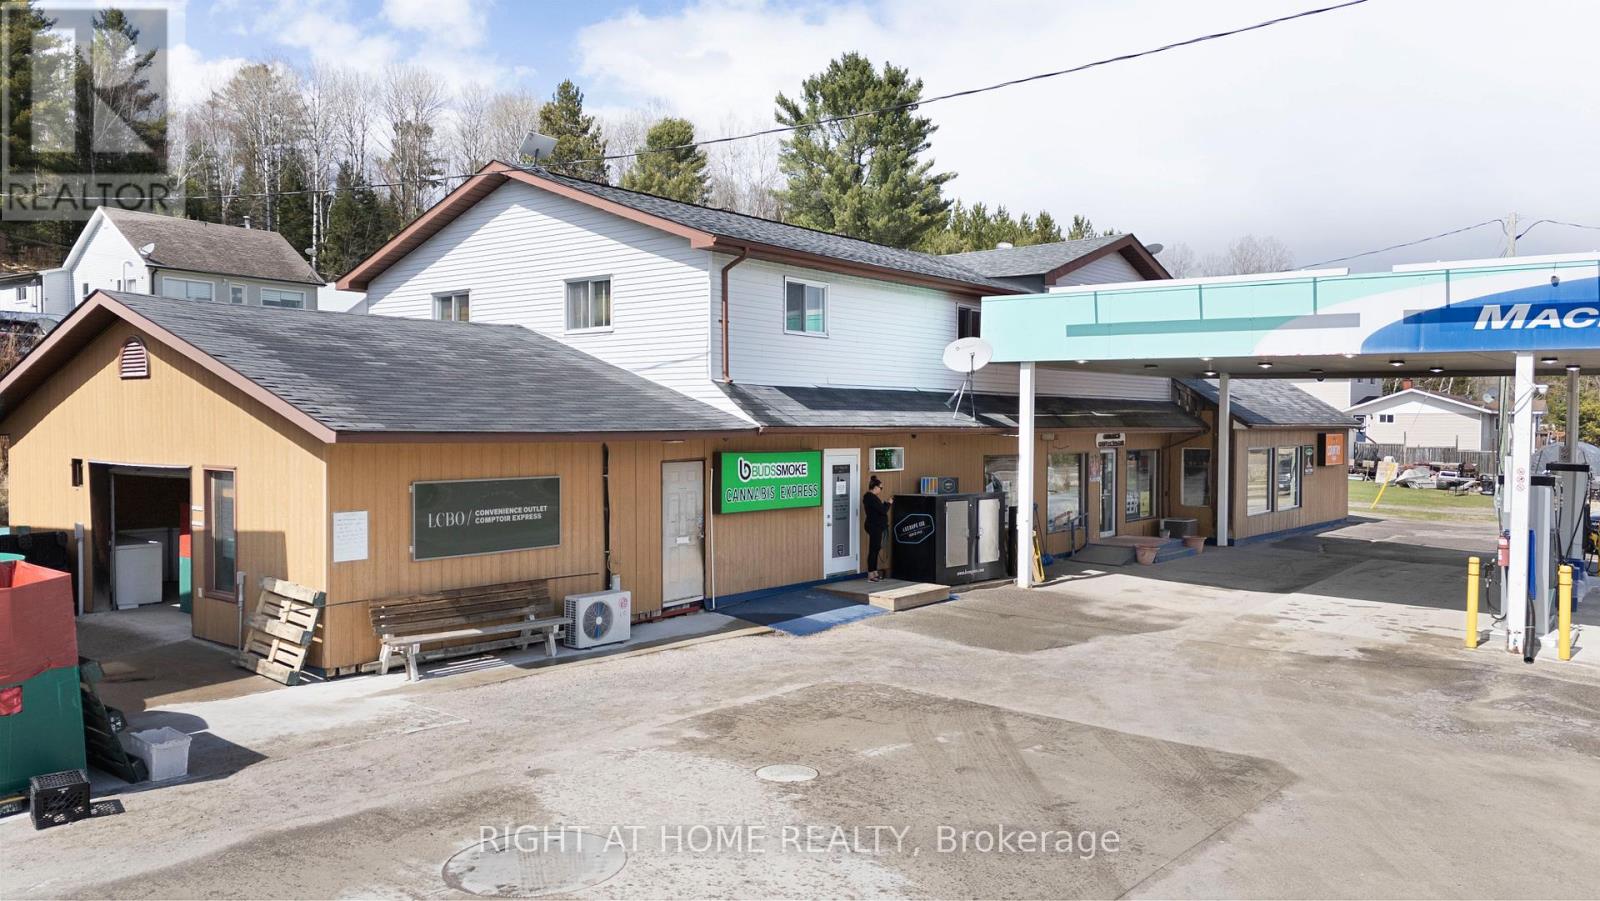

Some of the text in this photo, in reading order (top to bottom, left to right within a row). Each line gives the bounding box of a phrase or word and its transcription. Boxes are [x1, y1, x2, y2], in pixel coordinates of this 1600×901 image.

[1473, 303, 1600, 330] MAC
[726, 486, 775, 503] CANNABIS
[780, 484, 818, 499] EXPRESS
[474, 505, 548, 517] CONVENIENCE OUTLET
[474, 513, 542, 524] COMPTOIR EXPRESS
